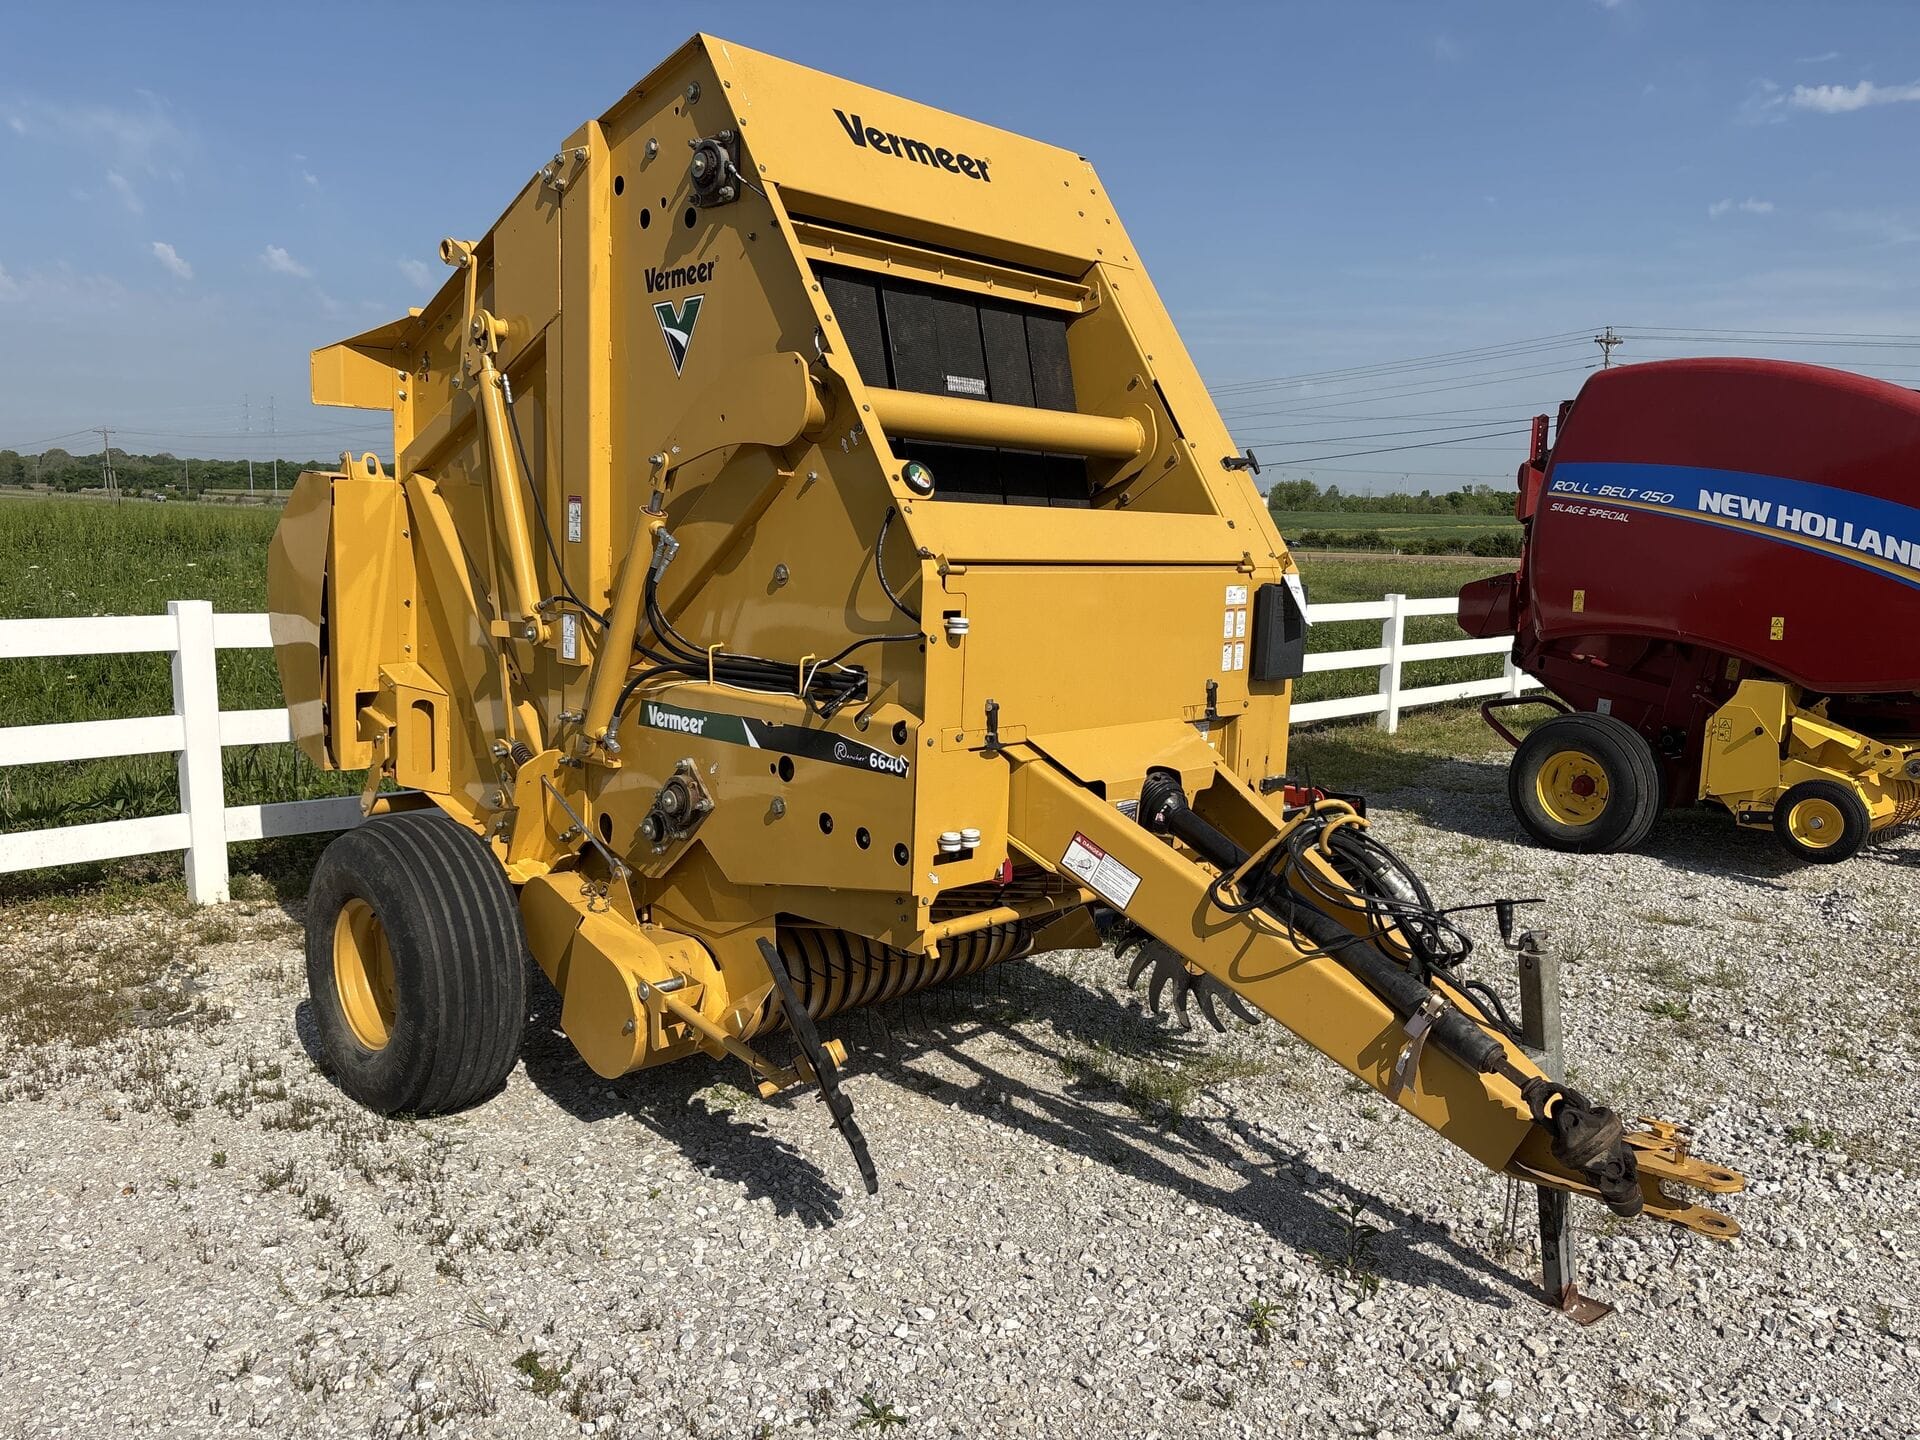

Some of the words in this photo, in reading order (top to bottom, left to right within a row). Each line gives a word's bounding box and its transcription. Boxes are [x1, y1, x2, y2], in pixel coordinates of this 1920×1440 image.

[832, 108, 991, 183] Vermeer
[644, 261, 715, 294] Vermeer
[1640, 490, 1675, 504] 450
[1698, 489, 1771, 524] NEW
[1550, 502, 1586, 517] SILAGE
[1587, 507, 1631, 523] SPECIAL
[648, 705, 705, 735] Vermeer
[870, 752, 904, 774] 6640
[1081, 840, 1104, 858] DANGER
